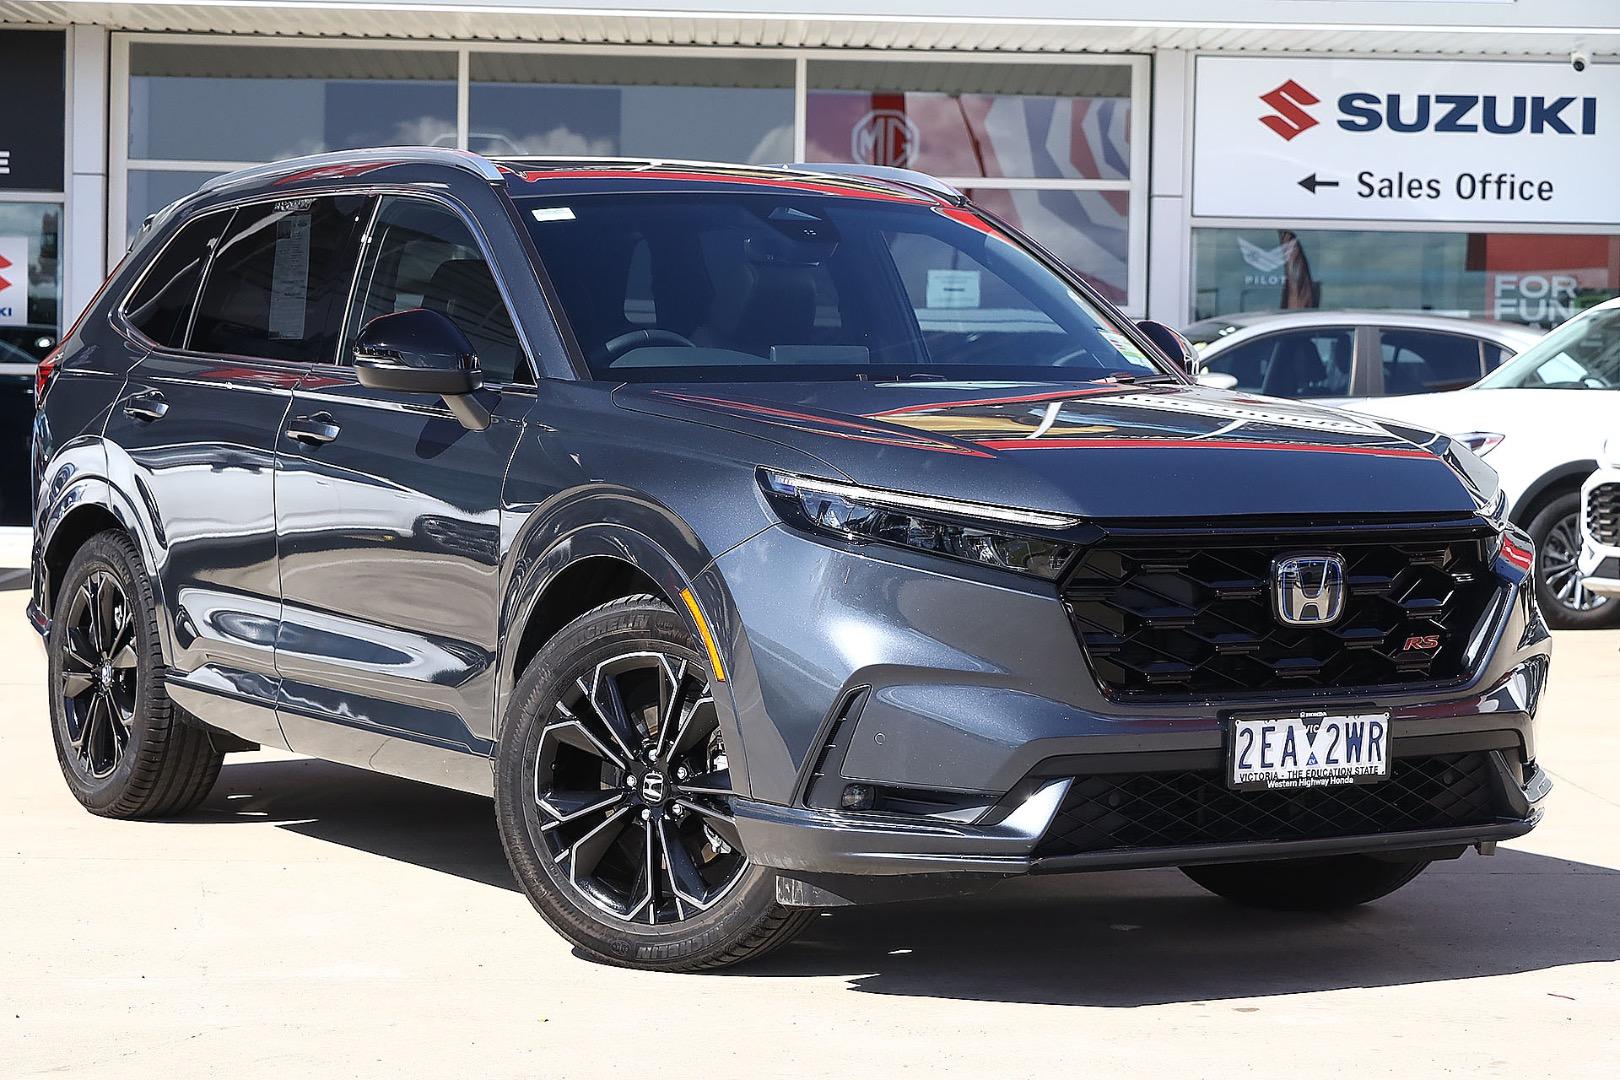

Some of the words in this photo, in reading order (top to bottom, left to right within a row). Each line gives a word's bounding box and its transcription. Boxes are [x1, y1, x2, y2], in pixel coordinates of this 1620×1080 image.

[1337, 92, 1597, 135] SUZUKI
[857, 114, 914, 167] MG
[1357, 171, 1441, 199] Sales
[1456, 173, 1554, 201] Office
[1244, 275, 1287, 285] PILOT
[1494, 275, 1578, 299] FOR
[1494, 299, 1576, 321] FUN
[1403, 634, 1440, 651] RS
[1306, 724, 1319, 733] VIC
[1238, 725, 1298, 770] 2EA
[1325, 721, 1384, 765] 2WR
[1239, 771, 1279, 783] VICTORIA
[1287, 769, 1304, 779] THE
[1305, 767, 1352, 778] EDUCATION
[1354, 765, 1379, 775] STATE
[1266, 778, 1298, 789] Western
[1299, 776, 1330, 787] Highway
[1330, 775, 1354, 785] Honda
